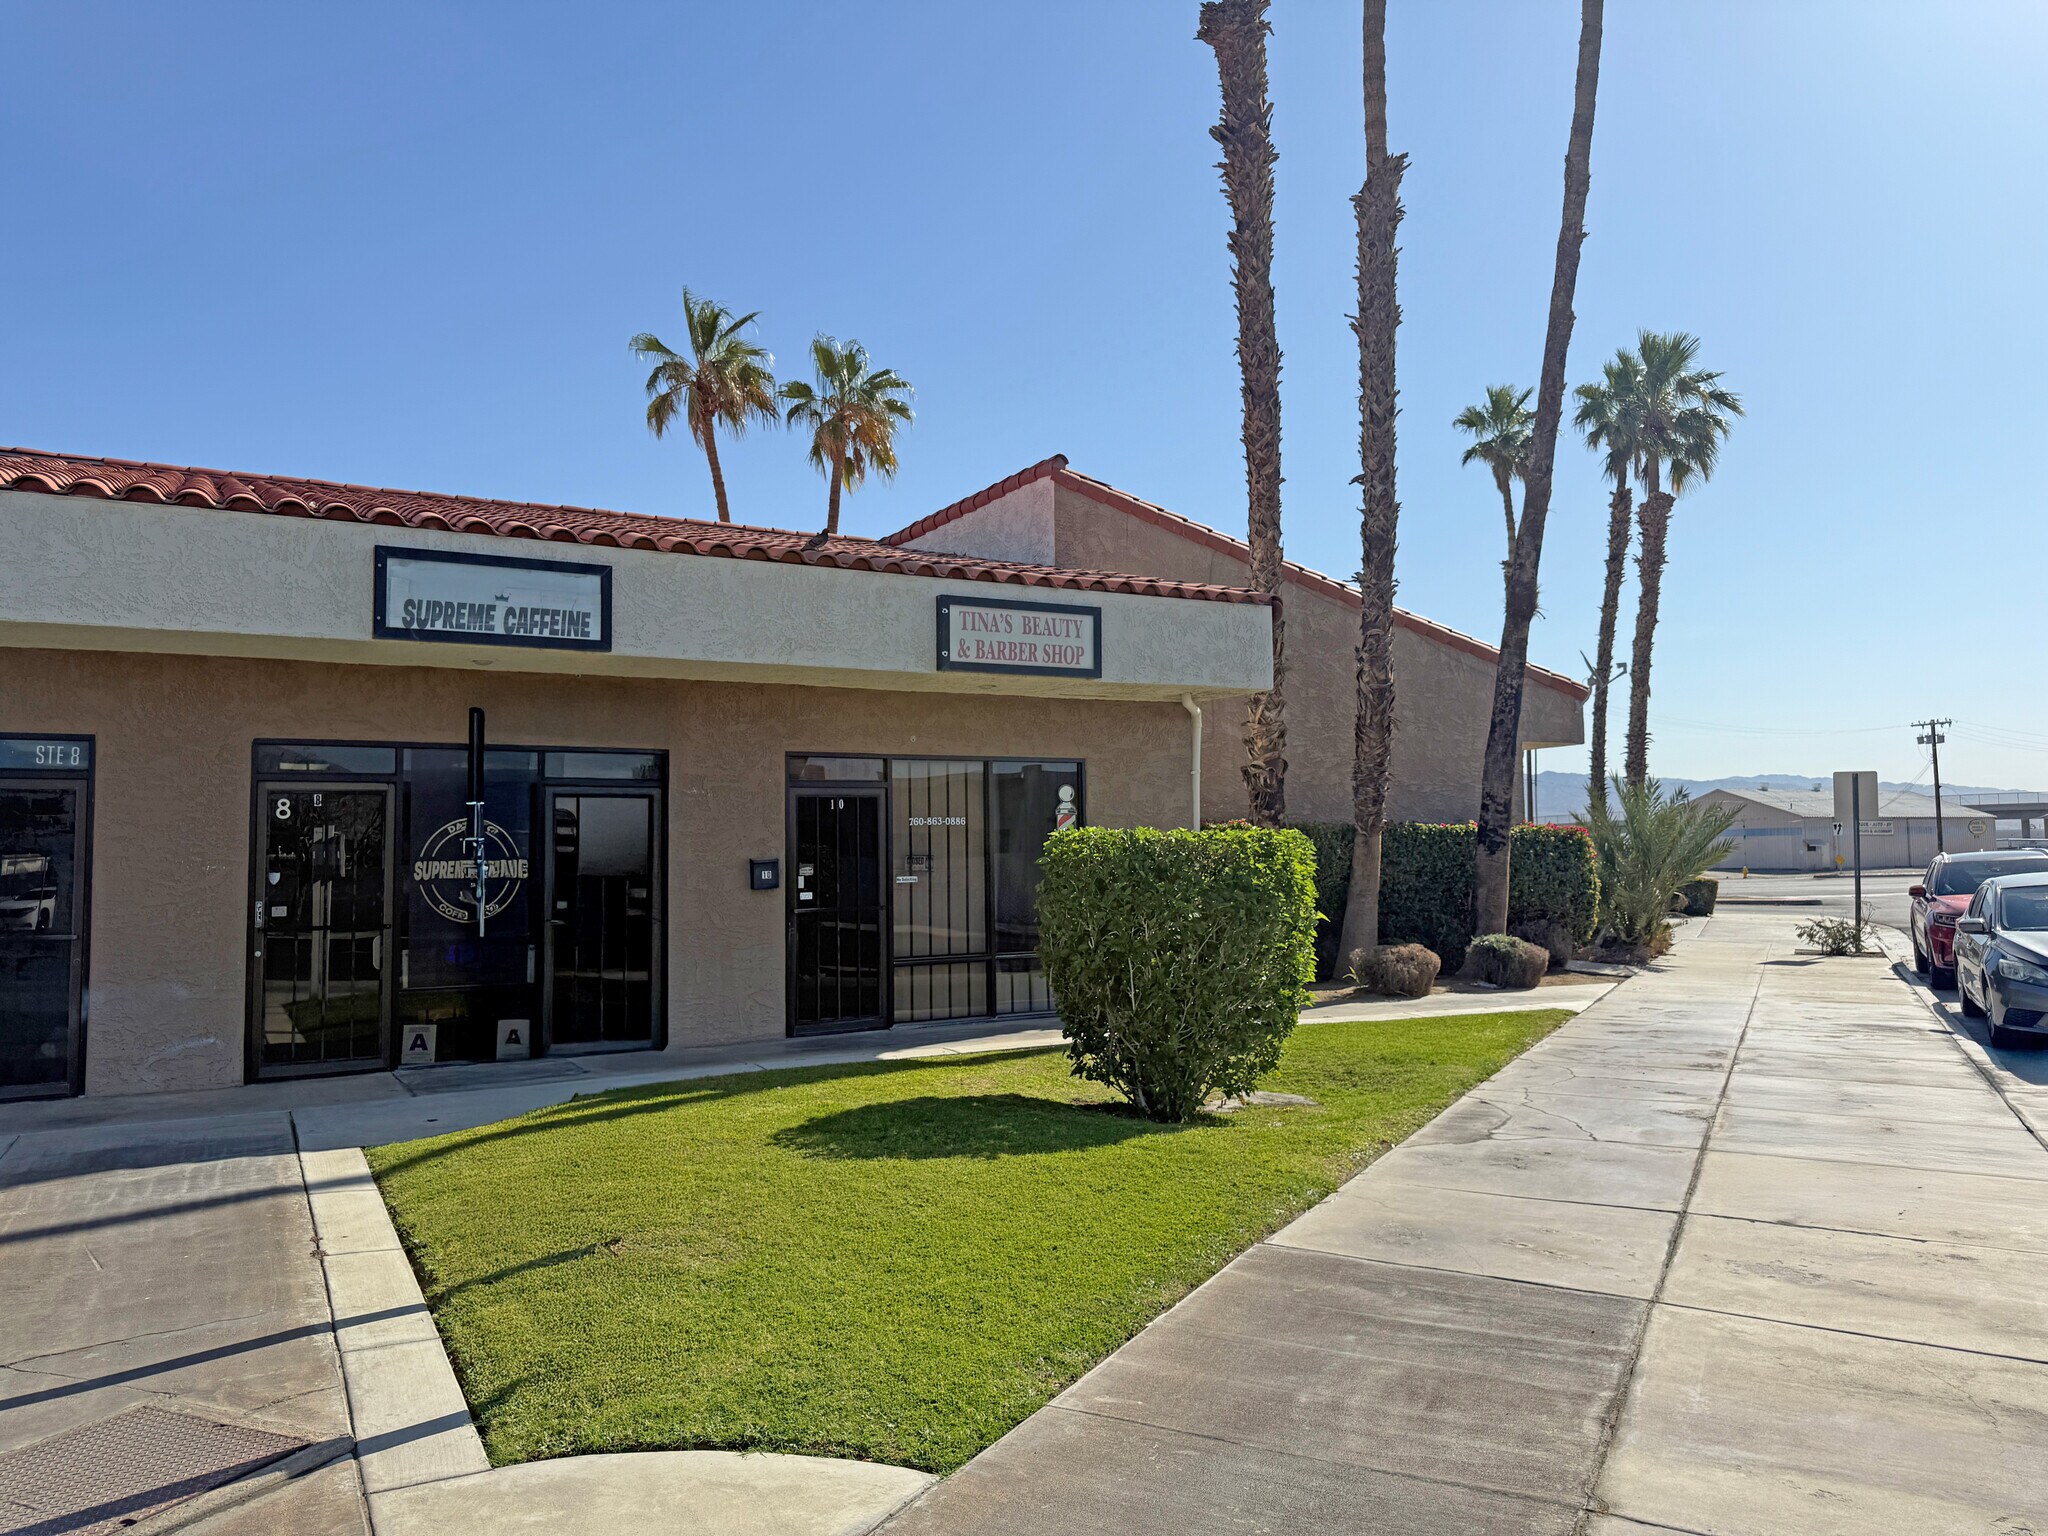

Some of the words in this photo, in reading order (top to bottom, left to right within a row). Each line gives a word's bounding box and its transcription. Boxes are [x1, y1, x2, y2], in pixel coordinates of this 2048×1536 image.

[402, 599, 497, 632] SUPREME
[503, 606, 591, 638] CAFFEINE
[959, 610, 1013, 634] TINA'S
[1021, 615, 1083, 639] BEAUTY
[957, 638, 971, 659] &
[975, 639, 1038, 663] BARBER
[1042, 643, 1085, 665] SHOP
[35, 745, 65, 765] STE
[70, 746, 80, 766] 8
[276, 798, 291, 820] 8
[830, 799, 844, 810] 10
[908, 816, 966, 826] 760-863-0886
[409, 1033, 428, 1051] A
[505, 1029, 521, 1045] A
